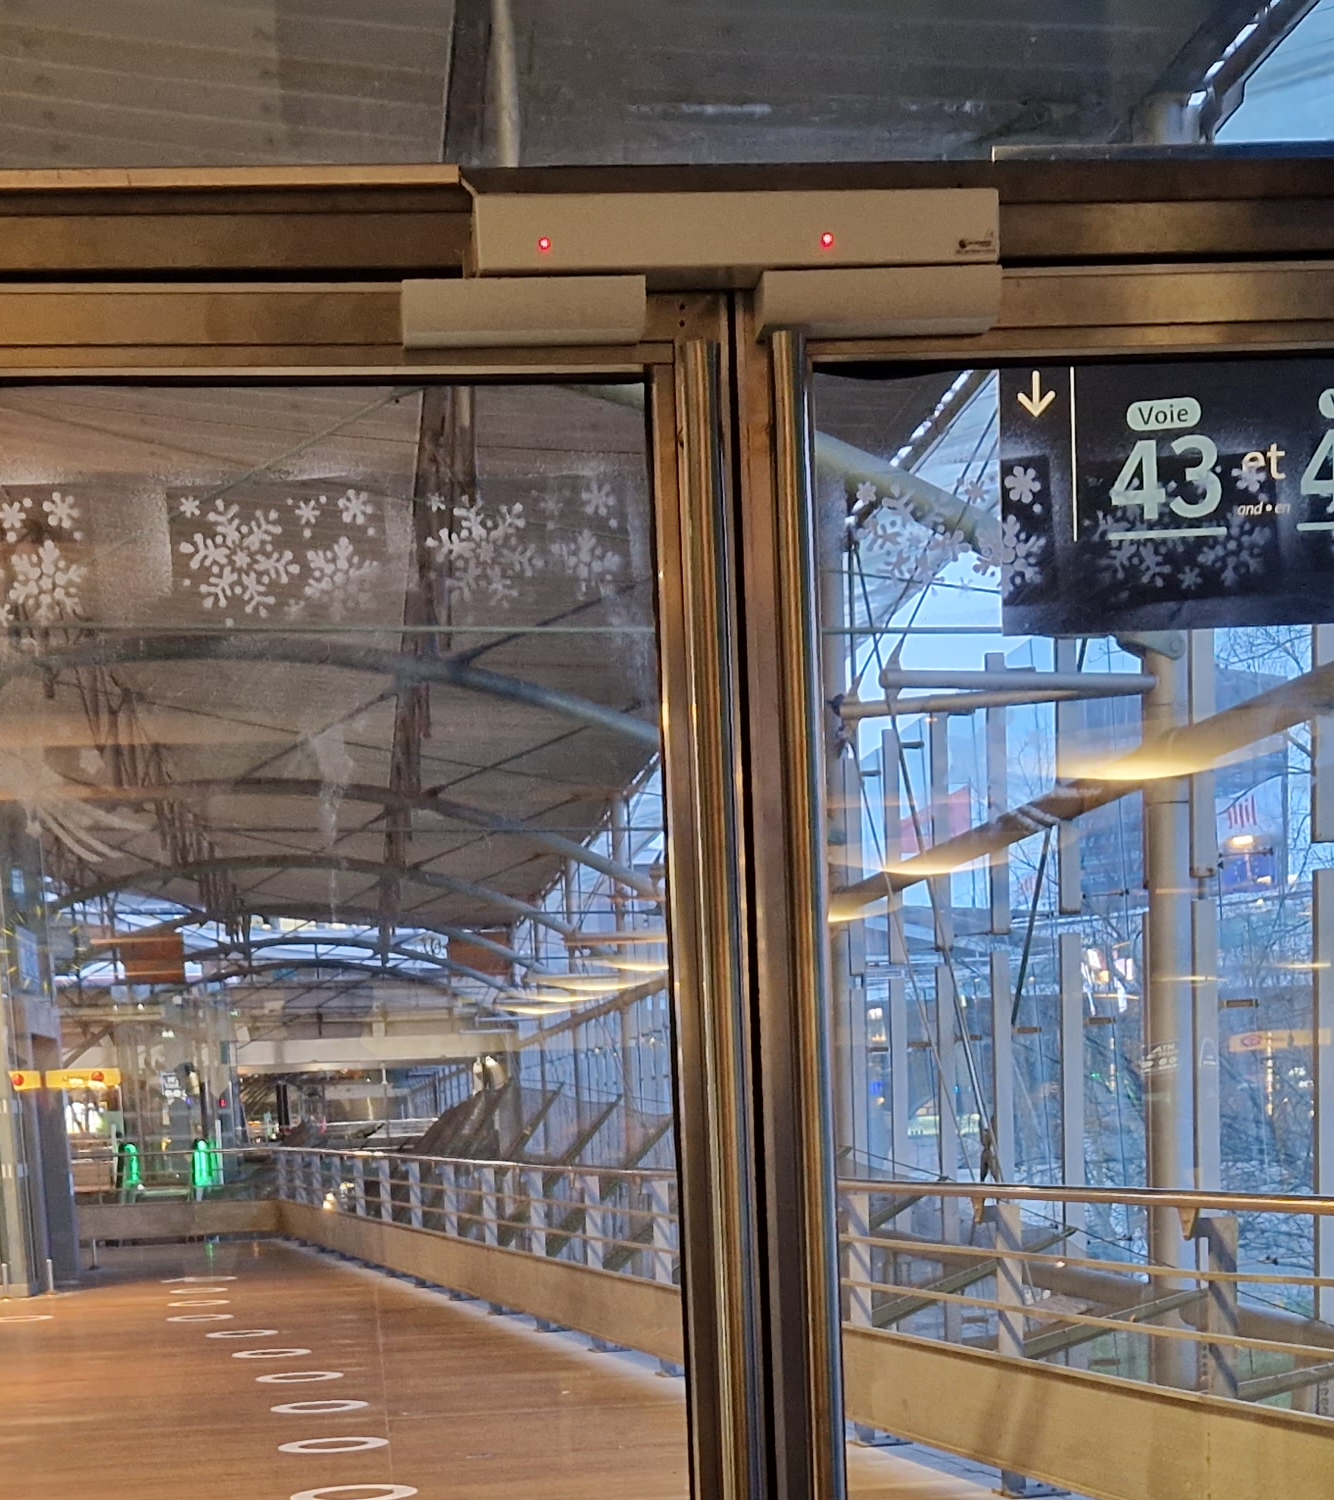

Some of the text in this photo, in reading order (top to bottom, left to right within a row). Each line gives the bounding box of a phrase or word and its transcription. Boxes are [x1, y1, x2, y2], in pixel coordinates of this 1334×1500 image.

[1137, 403, 1189, 426] Voie
[1110, 433, 1223, 520] 43
[1241, 442, 1287, 480] et
[1237, 501, 1264, 516] and
